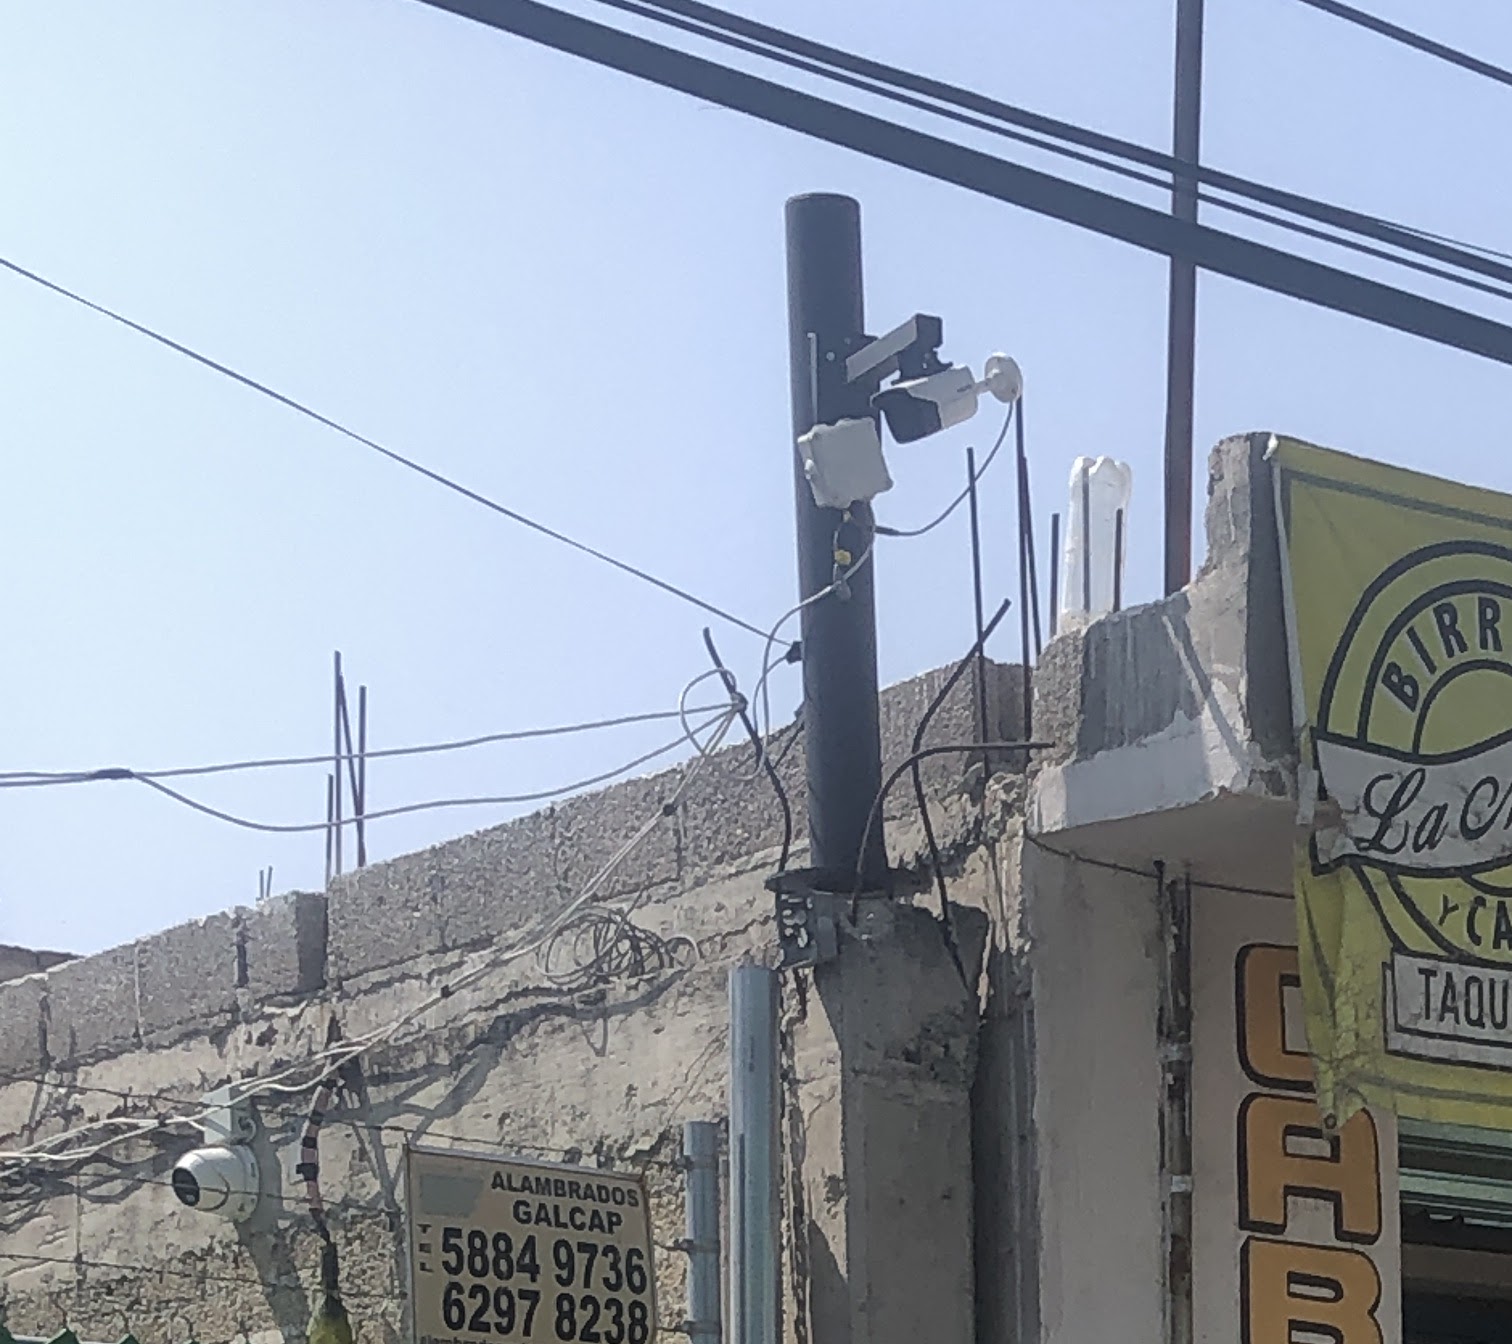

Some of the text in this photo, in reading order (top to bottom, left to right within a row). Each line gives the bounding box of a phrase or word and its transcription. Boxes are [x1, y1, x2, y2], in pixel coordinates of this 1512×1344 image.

[1354, 770, 1448, 854] La
[491, 1171, 640, 1207] ALAMBRADOS
[512, 1200, 623, 1235] GALCAP
[441, 1227, 648, 1295] 5884 9736
[443, 1281, 541, 1338] 6297
